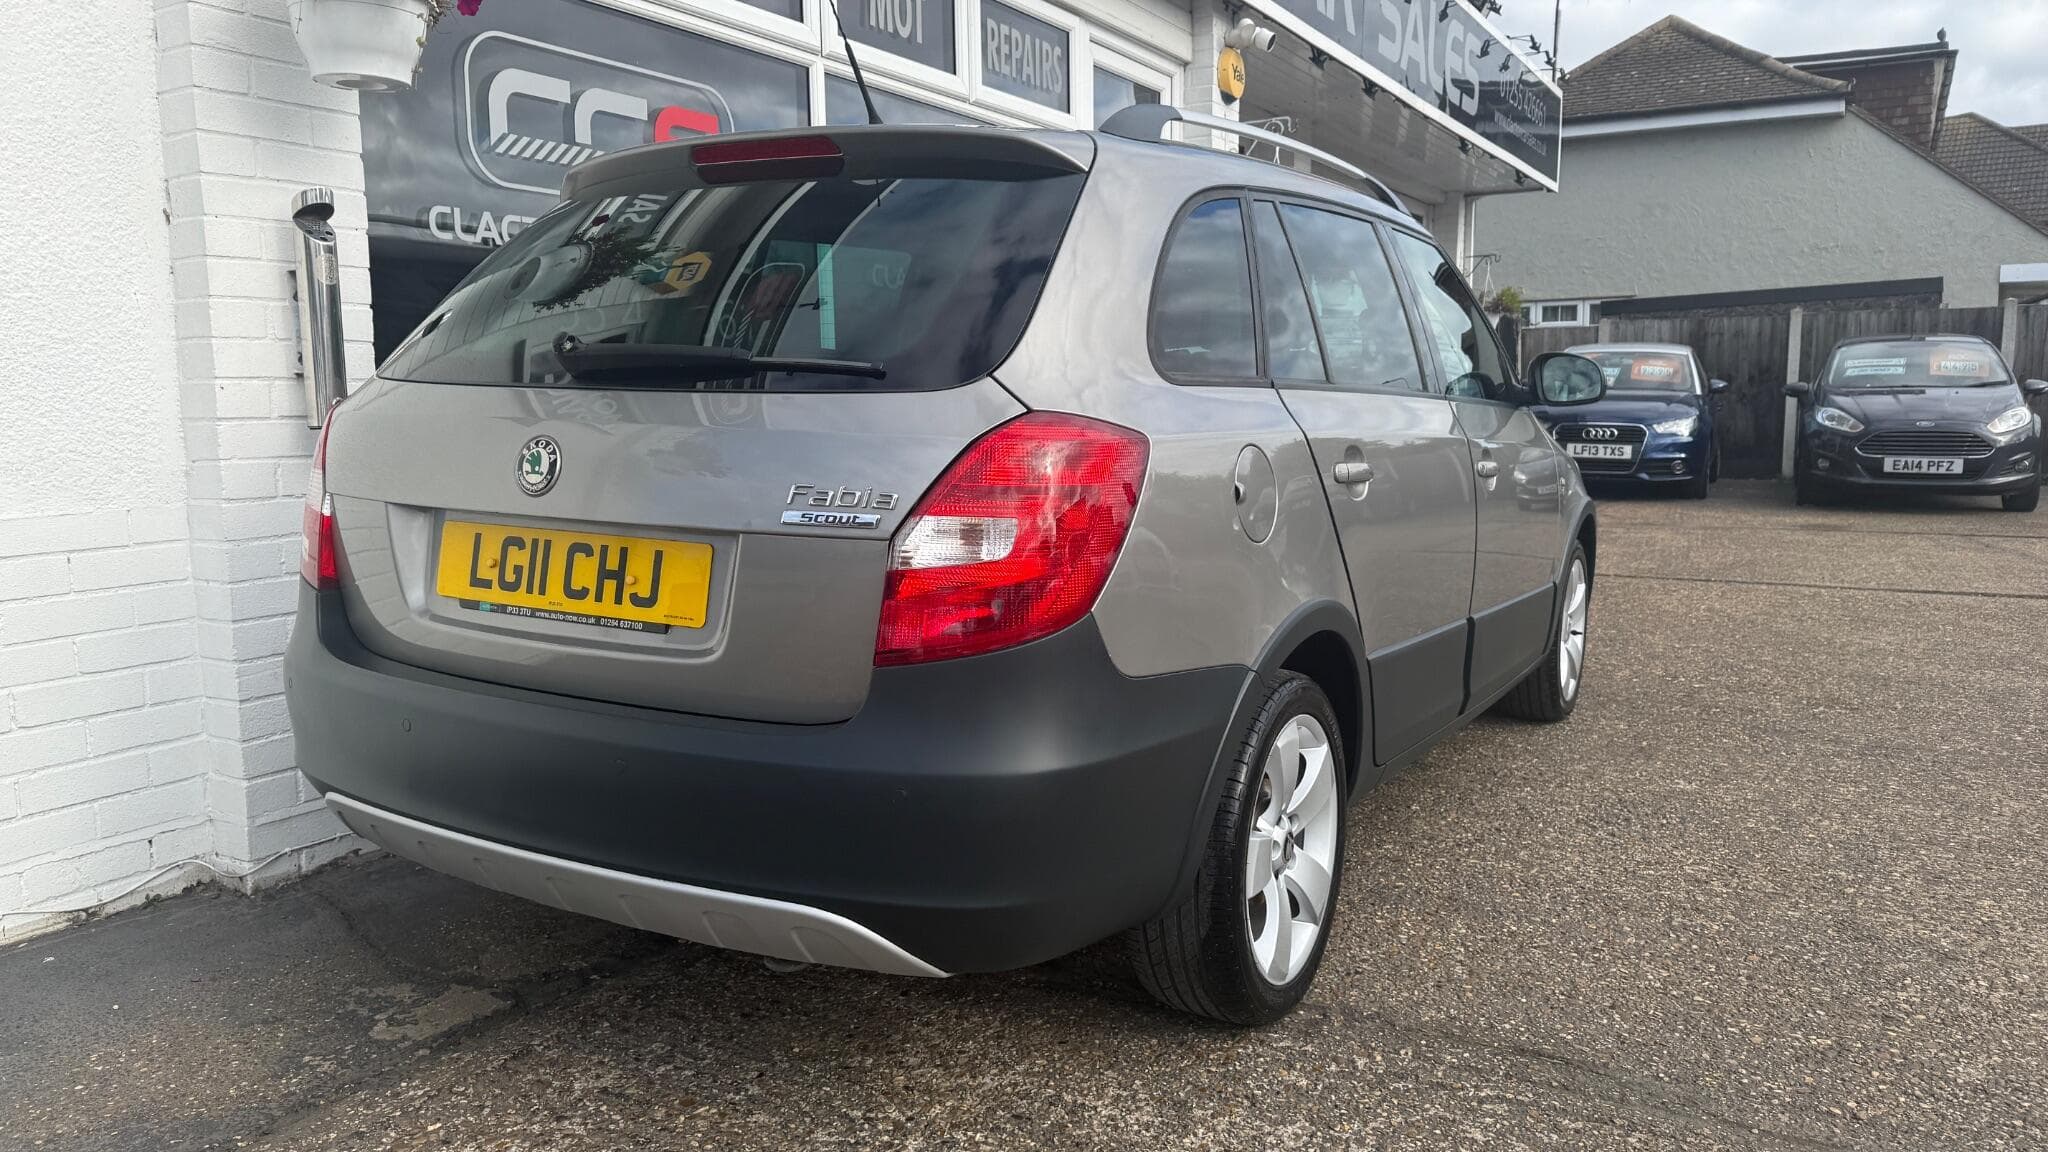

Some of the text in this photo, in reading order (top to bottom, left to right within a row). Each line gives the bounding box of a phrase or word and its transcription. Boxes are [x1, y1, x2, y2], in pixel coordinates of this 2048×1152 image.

[869, 0, 923, 44] MOT
[986, 17, 1063, 94] REPAIRS
[1377, 0, 1482, 117] SALES
[1573, 444, 1624, 457] LF13 TXS
[1892, 459, 1954, 473] EA14 PFZ
[787, 483, 899, 510] Fabia
[469, 532, 664, 609] LG11 CHJ
[520, 607, 532, 616] 3TU
[620, 621, 643, 631] 637100
